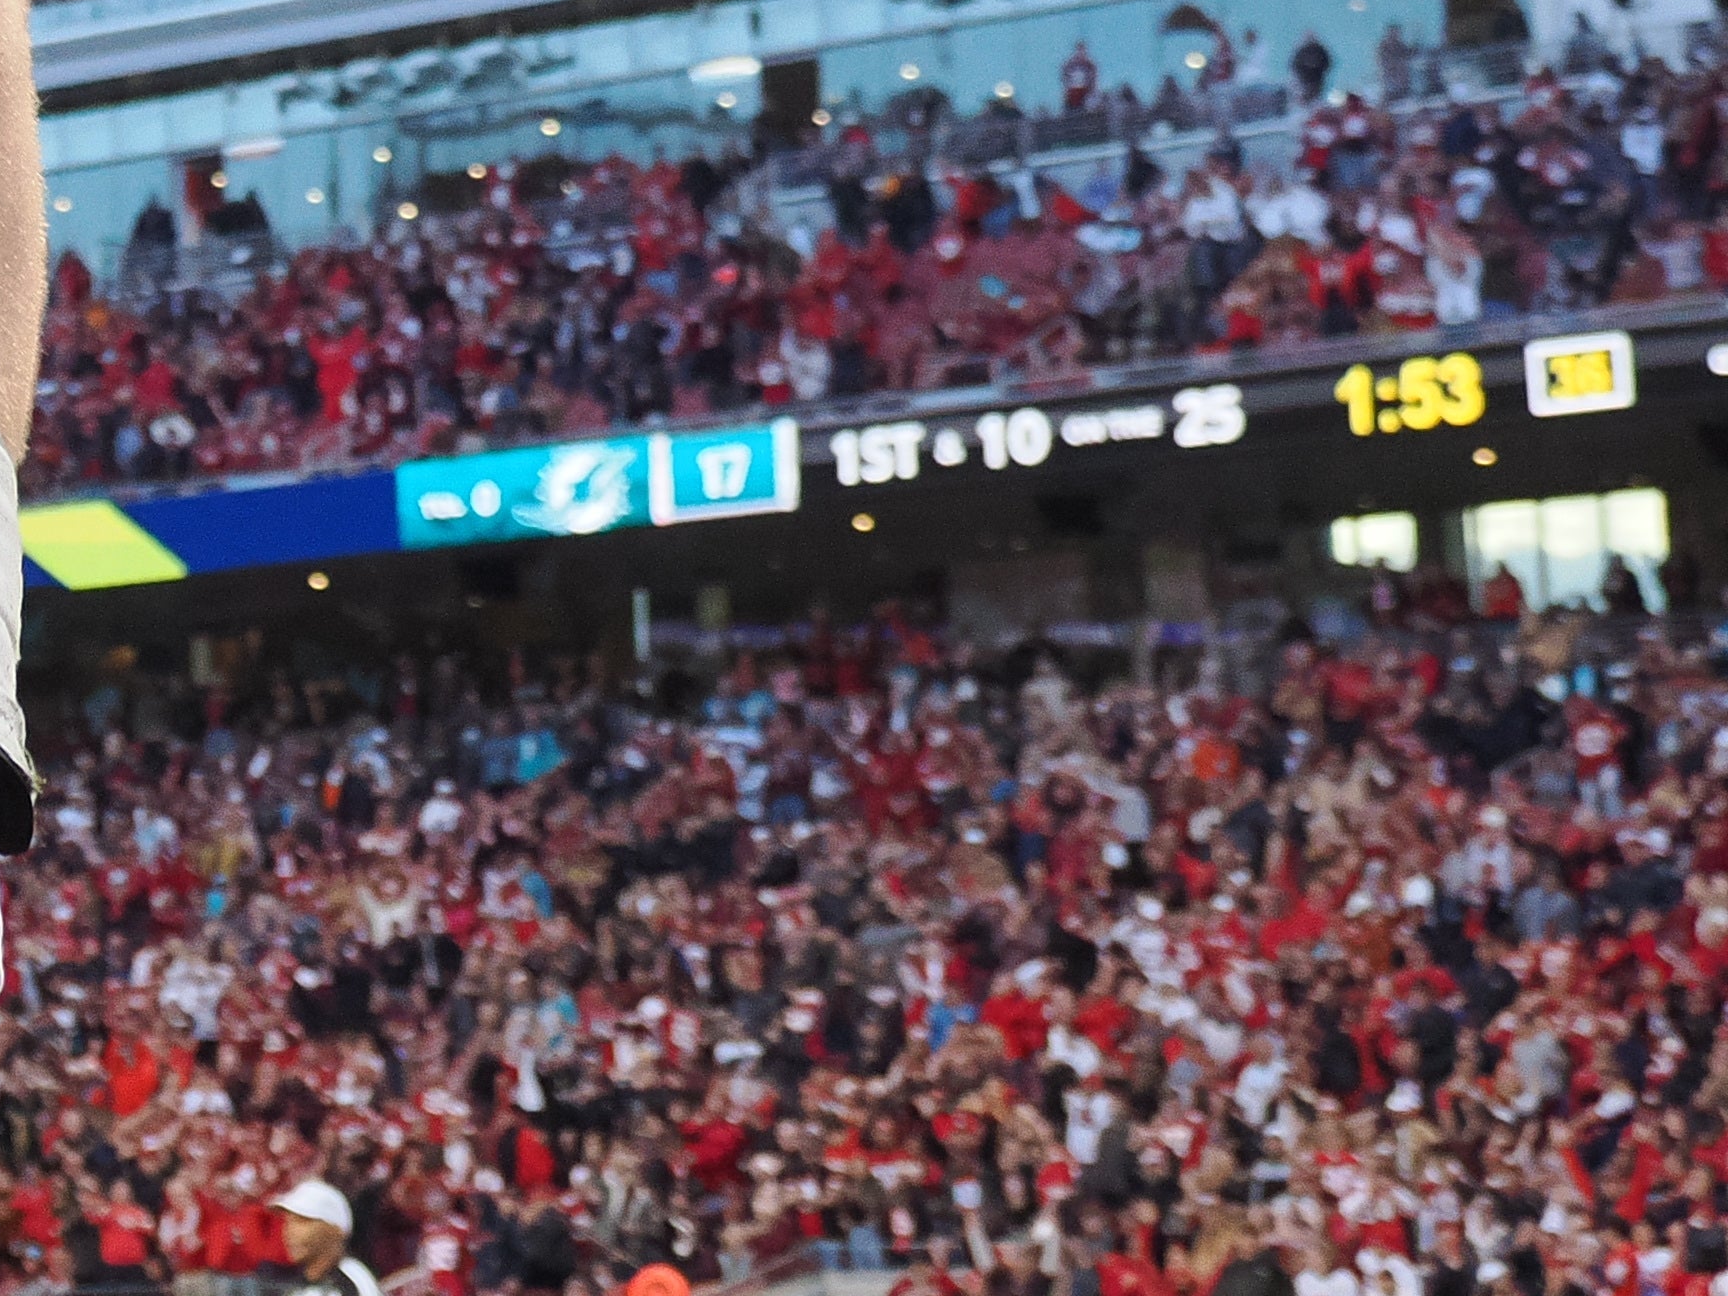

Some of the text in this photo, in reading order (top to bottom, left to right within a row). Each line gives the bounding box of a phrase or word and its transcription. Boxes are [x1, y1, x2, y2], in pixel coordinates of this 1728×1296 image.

[830, 421, 927, 487] 1ST
[975, 407, 1053, 471] 10
[1173, 384, 1247, 448] 25
[1334, 352, 1486, 437] 1:53
[696, 443, 752, 500] 17
